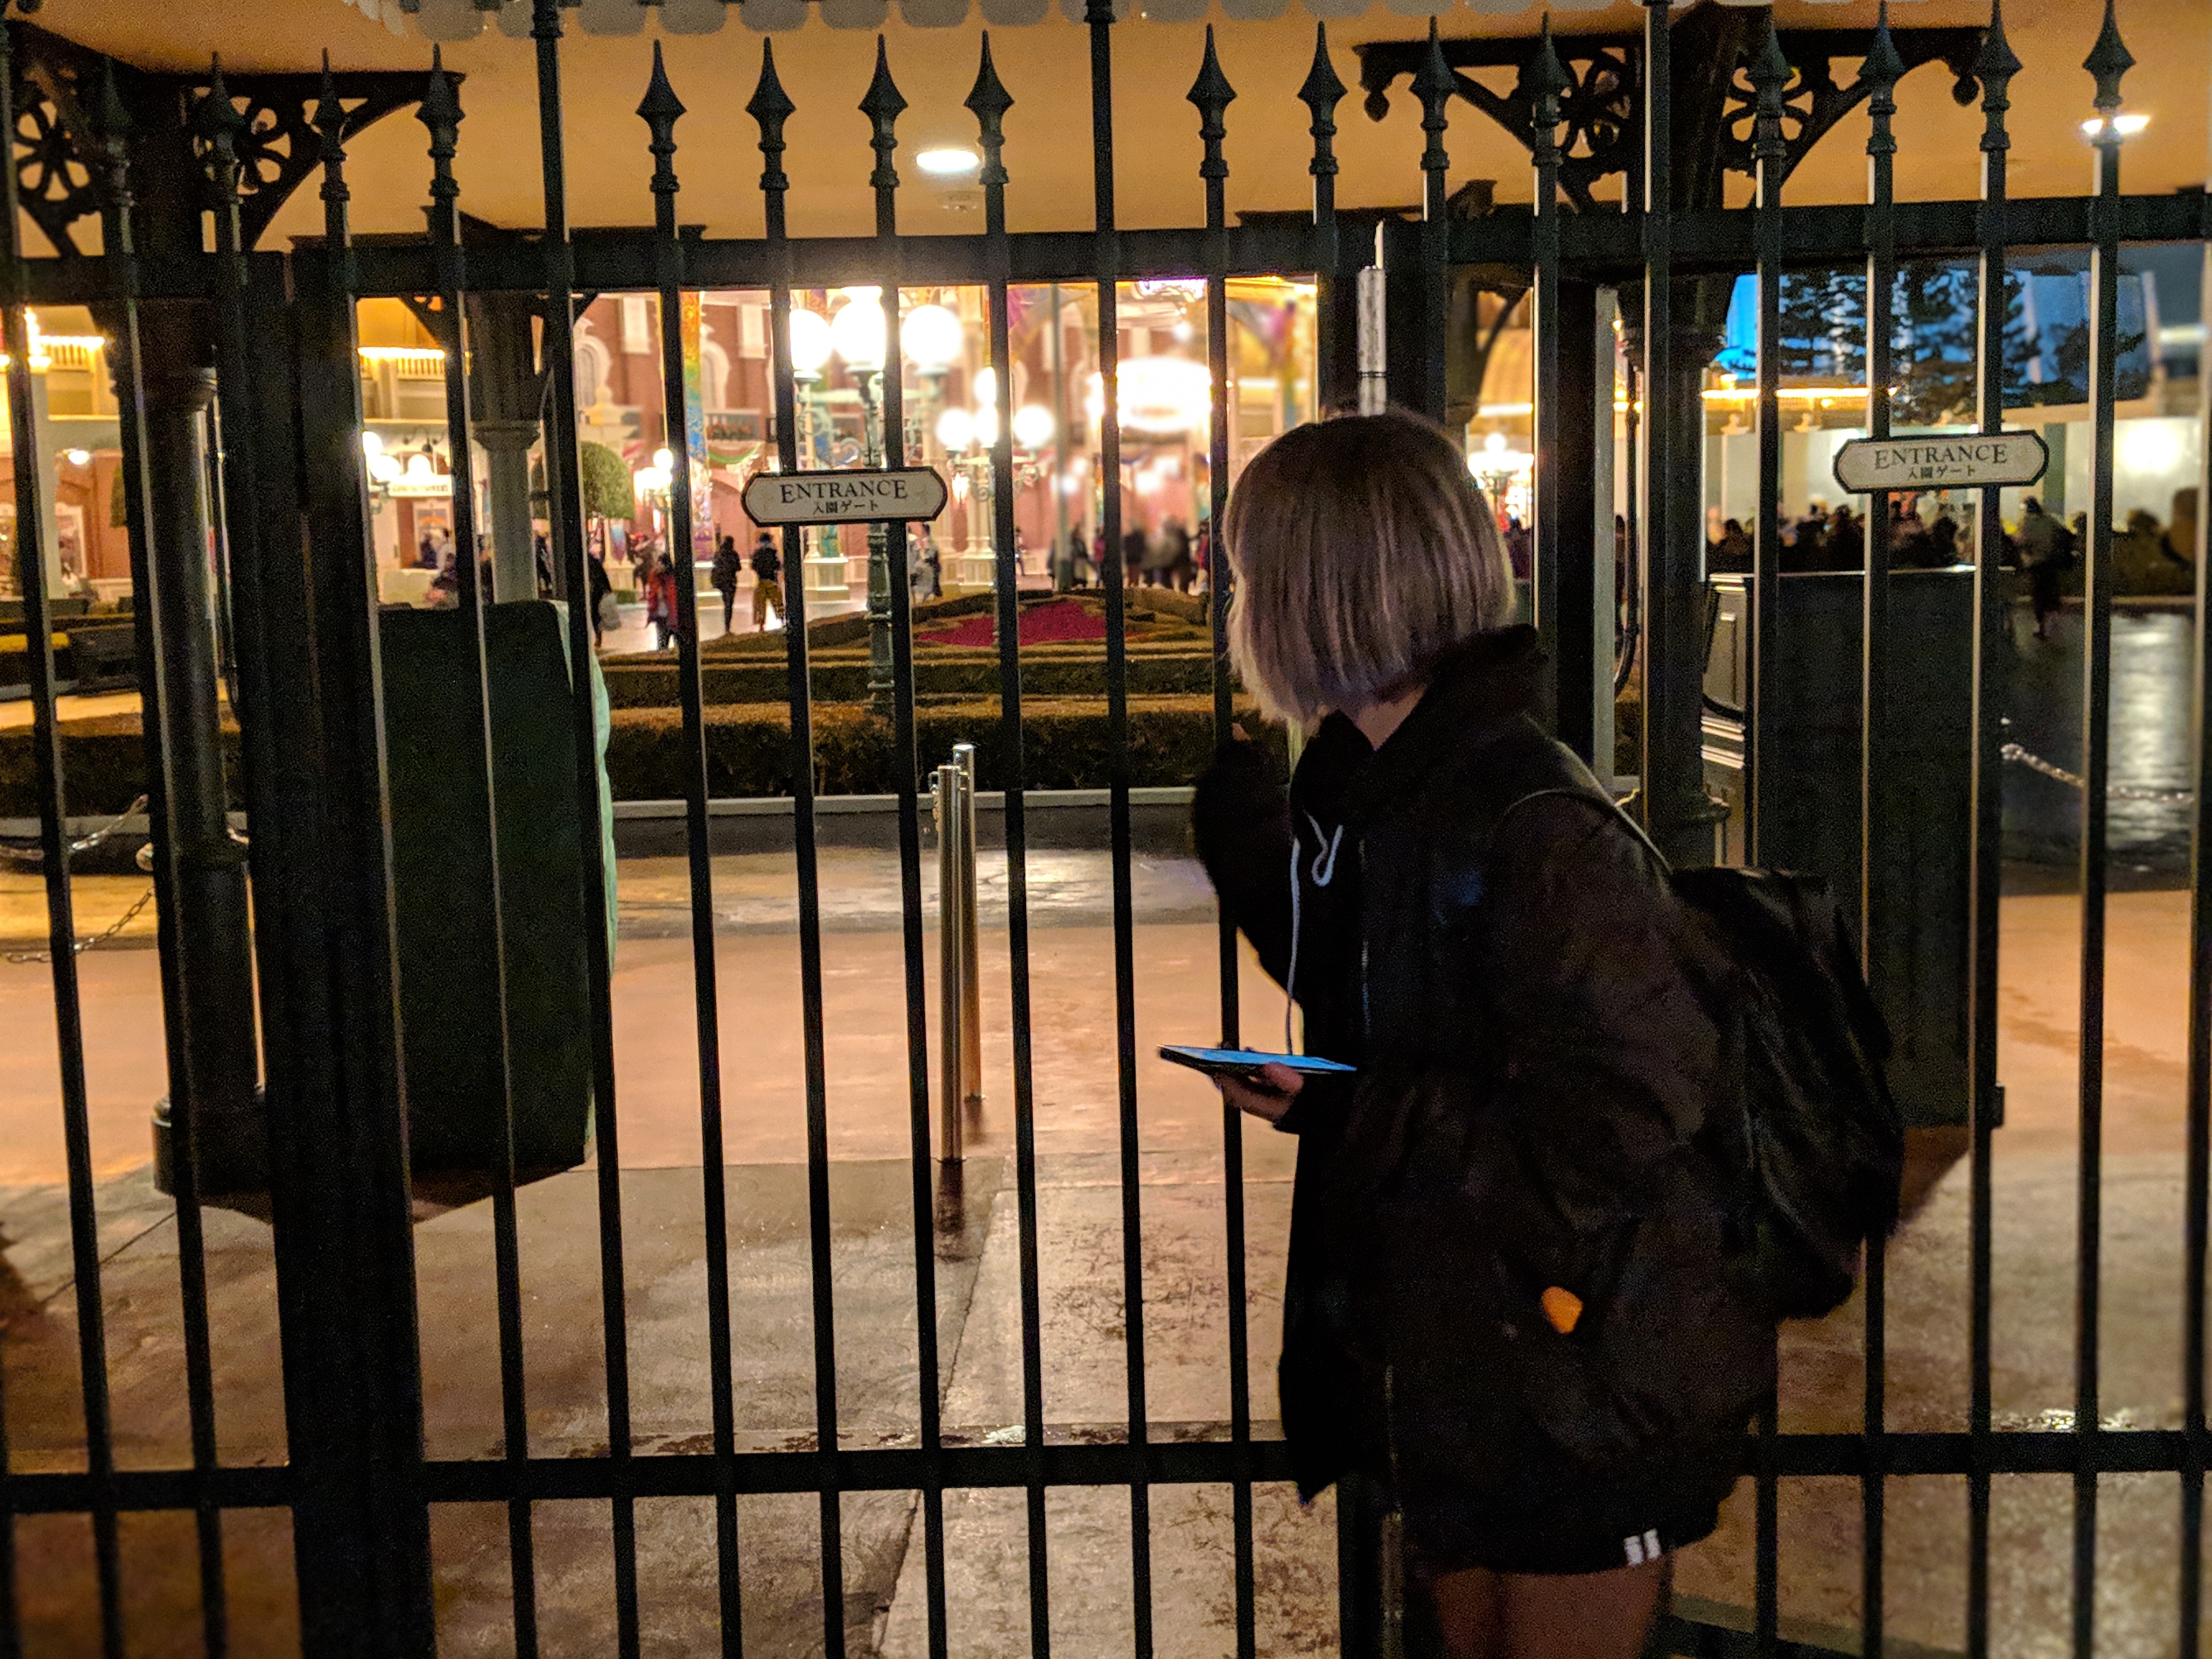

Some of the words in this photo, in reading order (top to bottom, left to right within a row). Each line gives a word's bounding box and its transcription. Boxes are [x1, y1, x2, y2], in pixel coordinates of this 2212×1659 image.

[1875, 444, 2007, 470] ENTRANCE
[780, 480, 908, 503] ENTRANCE
[813, 500, 878, 514] 入園ゲート
